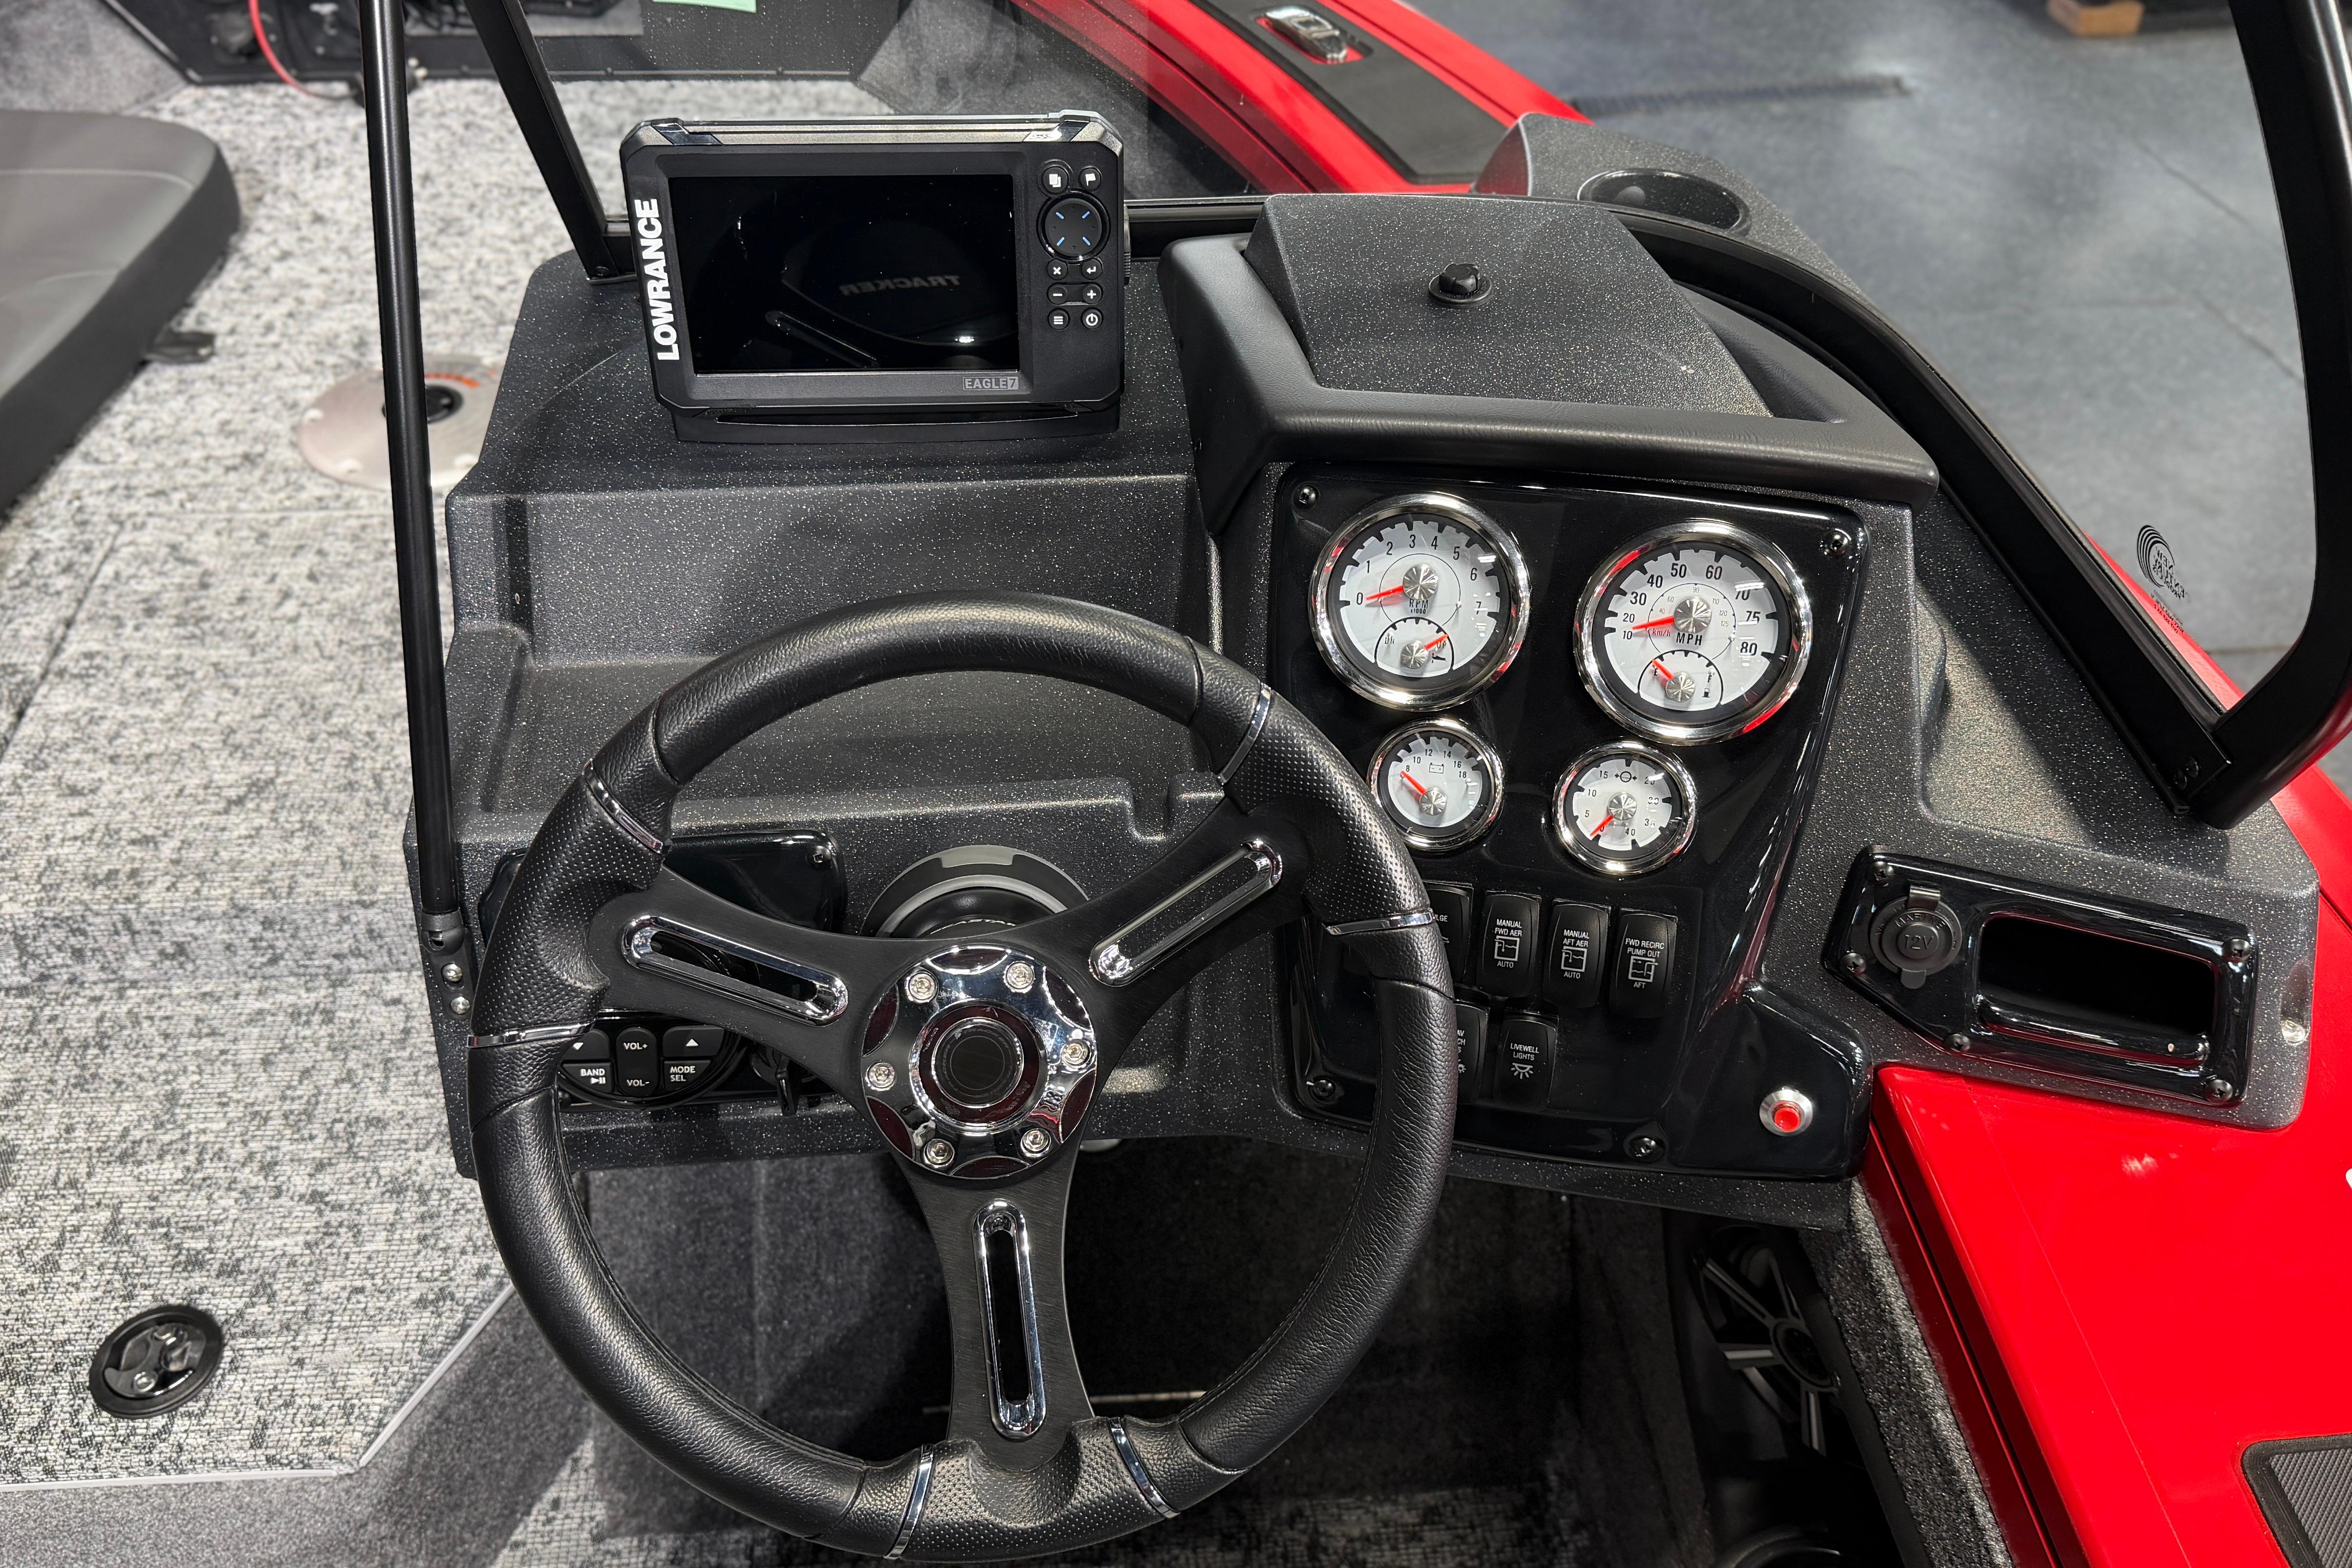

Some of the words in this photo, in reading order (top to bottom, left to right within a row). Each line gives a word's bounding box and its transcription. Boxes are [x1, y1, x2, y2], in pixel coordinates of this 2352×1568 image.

[634, 199, 679, 360] LOWRANCE
[1409, 535, 1416, 549] 3
[1431, 536, 1438, 550] 4
[1386, 542, 1393, 555] 2
[1453, 547, 1460, 560] 5
[1366, 561, 1370, 573] 1
[1671, 563, 1686, 578] 50
[1705, 565, 1723, 580] 60
[1470, 568, 1478, 581] 6
[1647, 574, 1663, 588] 40
[1356, 591, 1363, 605] 0
[1409, 598, 1428, 609] RPM
[1630, 591, 1646, 606] 30
[1476, 601, 1482, 614] 7
[1622, 613, 1635, 623] 20
[1745, 610, 1761, 624] 75
[1623, 631, 1633, 640] 10
[1652, 629, 1671, 637] km/h
[1676, 632, 1703, 646] MPH
[1740, 641, 1758, 656] 80
[1654, 668, 1659, 676] E
[1600, 770, 1608, 779] 15
[1588, 788, 1597, 797] 10
[1584, 810, 1590, 818] 5
[1625, 828, 1636, 836] 40
[1497, 918, 1522, 928] MANUAL
[1895, 913, 1946, 929] MARINE
[1495, 927, 1508, 936] FWD
[1563, 929, 1589, 939] MANUAL
[1625, 938, 1640, 946] FWD
[1641, 940, 1664, 949] RECIRC
[1905, 935, 1934, 950] 12V
[1627, 947, 1646, 956] PUMP
[1510, 1042, 1539, 1054] LIVEWELL
[1513, 1052, 1535, 1060] LIGHTS
[581, 1068, 605, 1077] BAND
